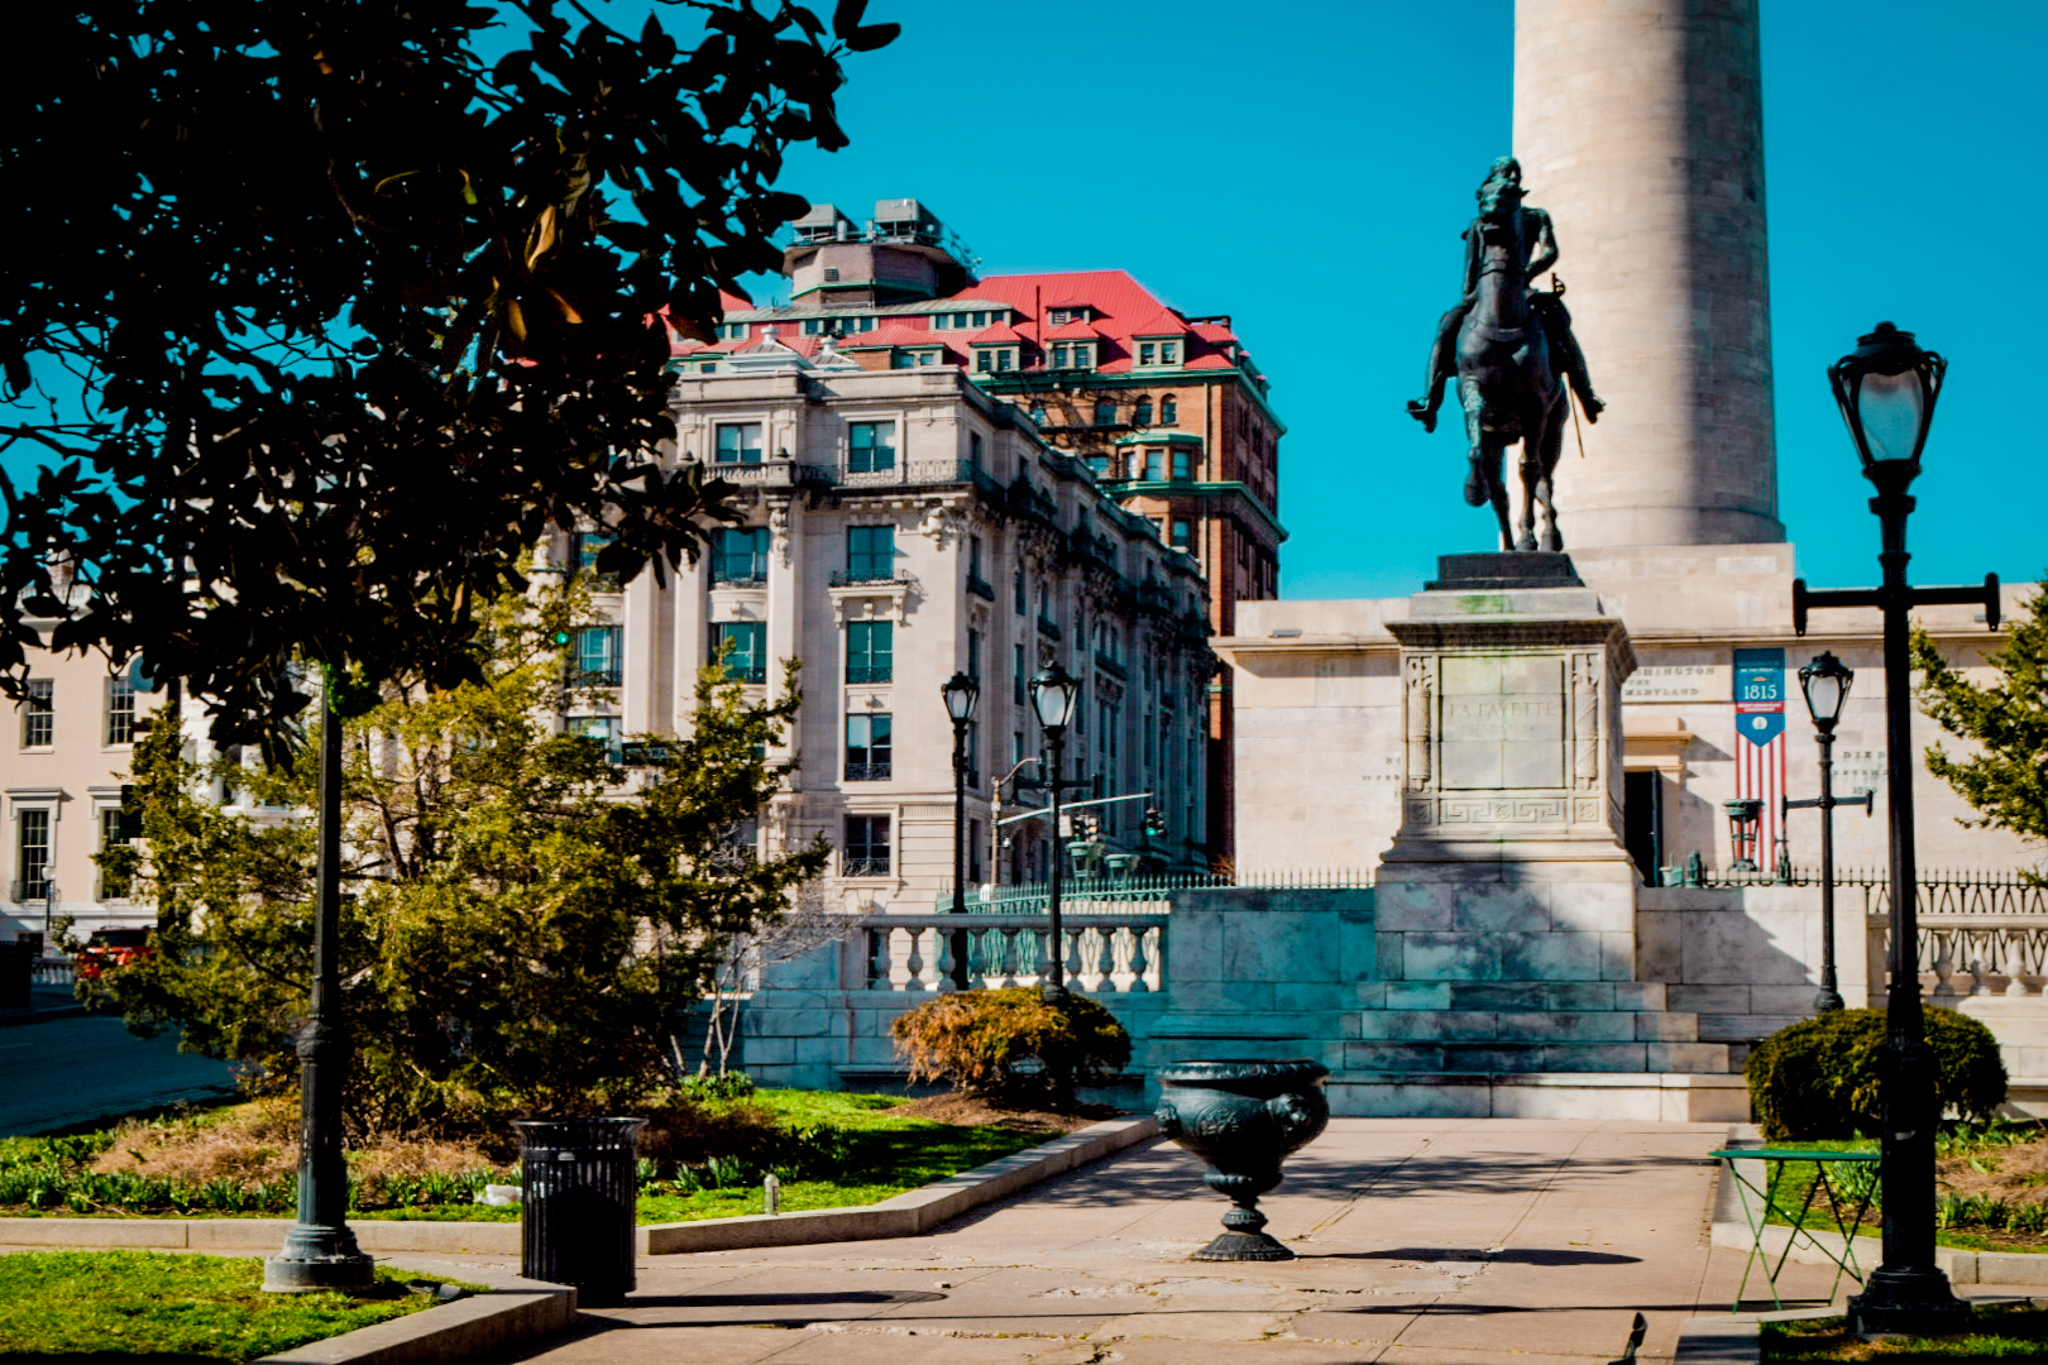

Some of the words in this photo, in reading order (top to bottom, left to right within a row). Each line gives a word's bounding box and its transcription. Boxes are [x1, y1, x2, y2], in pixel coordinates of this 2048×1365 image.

[1634, 667, 1715, 676] SHINGTON
[1625, 688, 1699, 696] MARYLAND
[1744, 684, 1777, 700] 1815
[1478, 701, 1558, 718] FAYETTE
[1843, 751, 1886, 759] DIED
